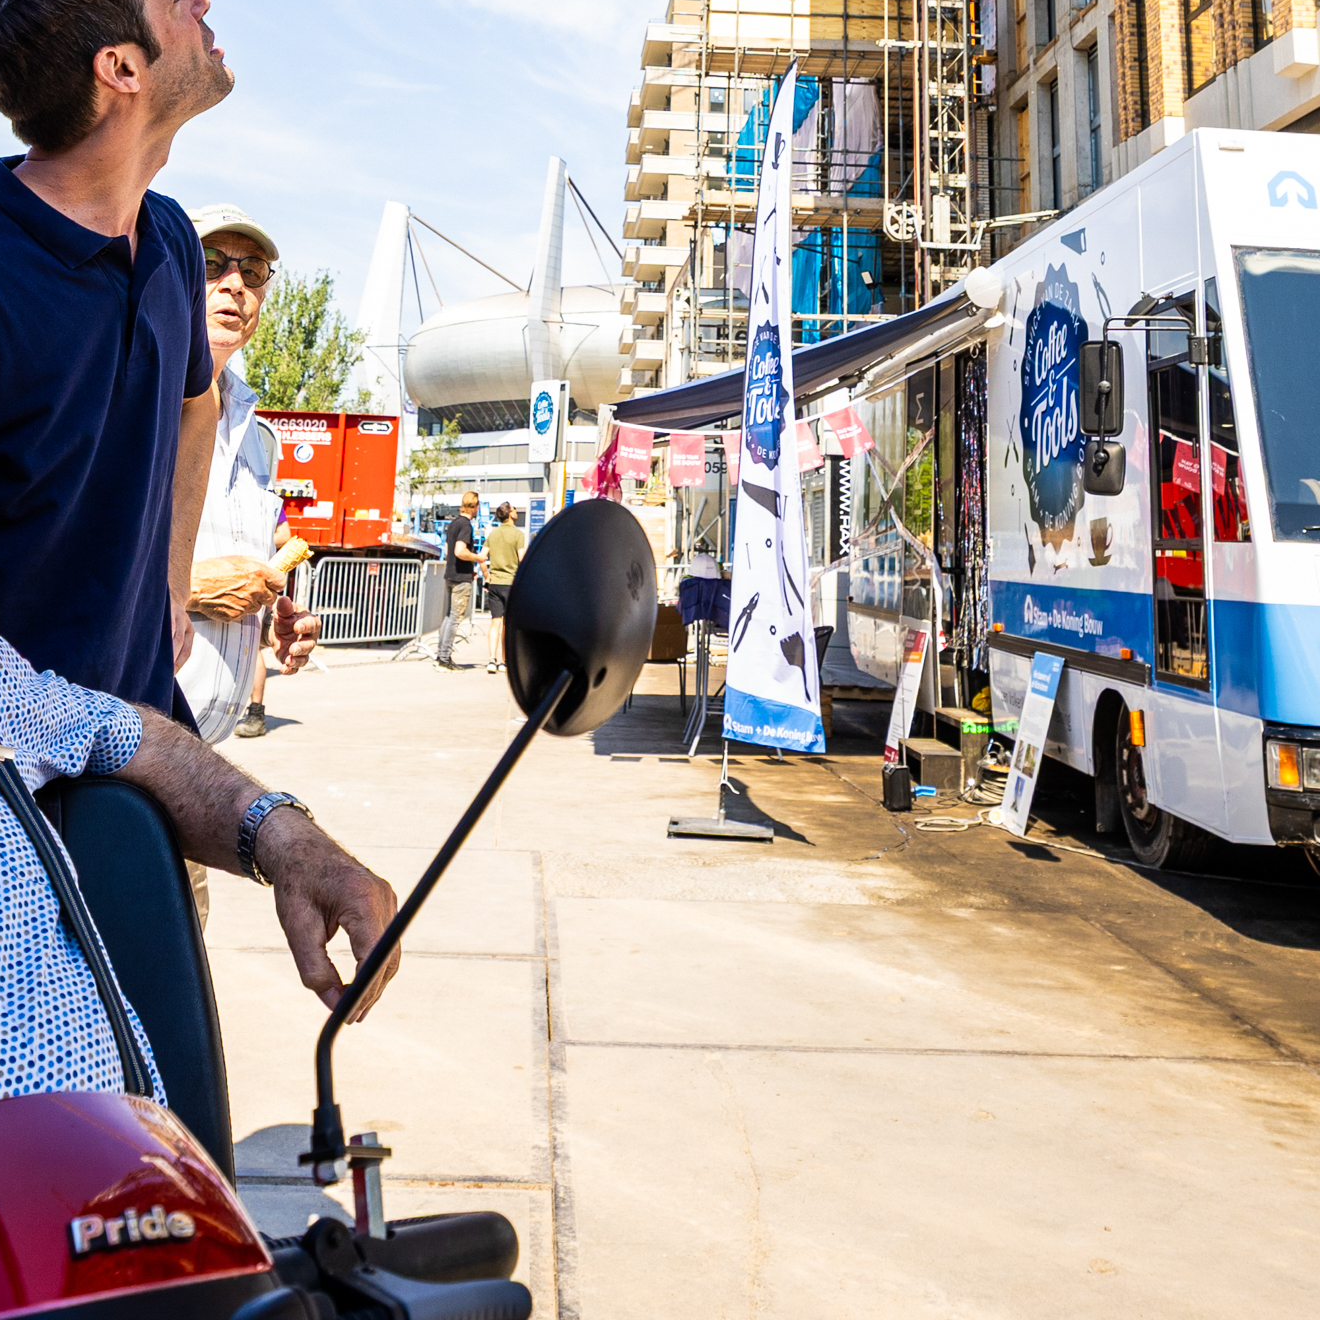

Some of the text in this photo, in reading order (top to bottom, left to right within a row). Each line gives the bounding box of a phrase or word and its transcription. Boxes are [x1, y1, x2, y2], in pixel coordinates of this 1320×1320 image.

[1054, 282, 1064, 300] DE
[1035, 320, 1068, 386] Coffee
[1048, 369, 1057, 407] &
[267, 417, 328, 432] 4G63020
[1032, 375, 1078, 474] Tools
[1033, 606, 1048, 627] Stam
[1053, 609, 1061, 628] De
[1061, 610, 1084, 638] Koning
[1084, 613, 1103, 636] Bouw
[731, 721, 754, 735] Stam
[763, 725, 776, 736] De
[777, 726, 806, 743] Koning
[70, 1204, 196, 1255] Pride
